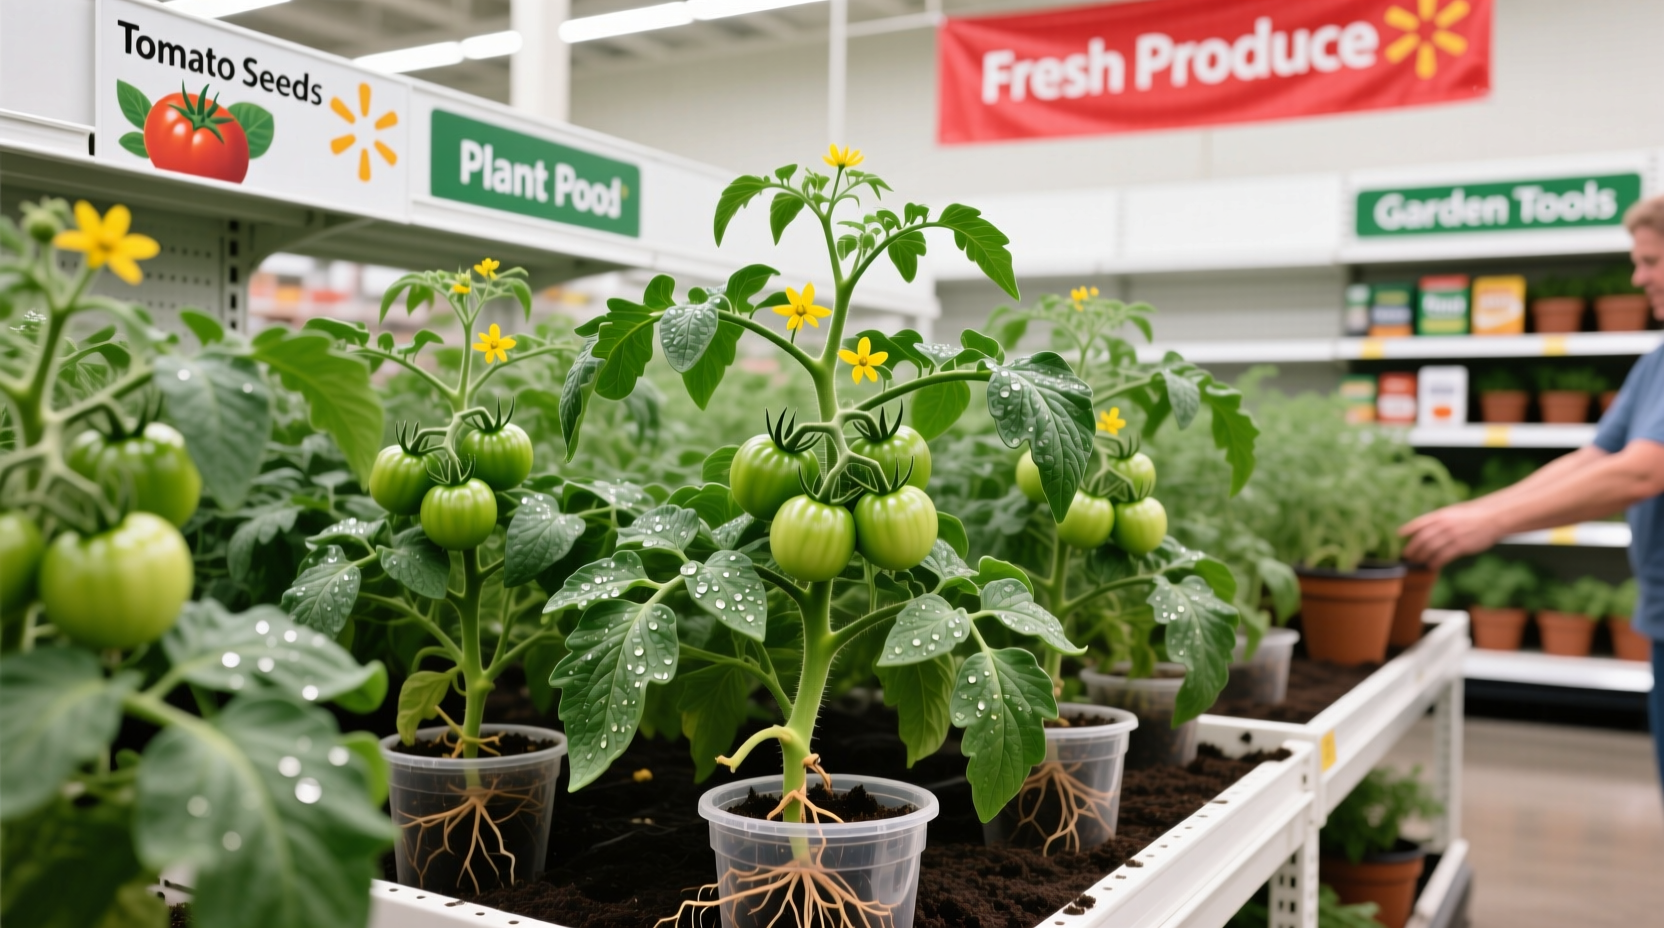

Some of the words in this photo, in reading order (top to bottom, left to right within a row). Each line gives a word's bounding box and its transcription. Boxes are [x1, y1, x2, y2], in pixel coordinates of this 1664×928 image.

[117, 19, 236, 81] Tomato
[242, 57, 322, 106] Seeds
[981, 38, 1125, 104] Fresh
[1135, 18, 1379, 90] Produce
[459, 139, 549, 203] Plant
[1373, 187, 1510, 231] Garden
[1512, 180, 1618, 224] Tools
